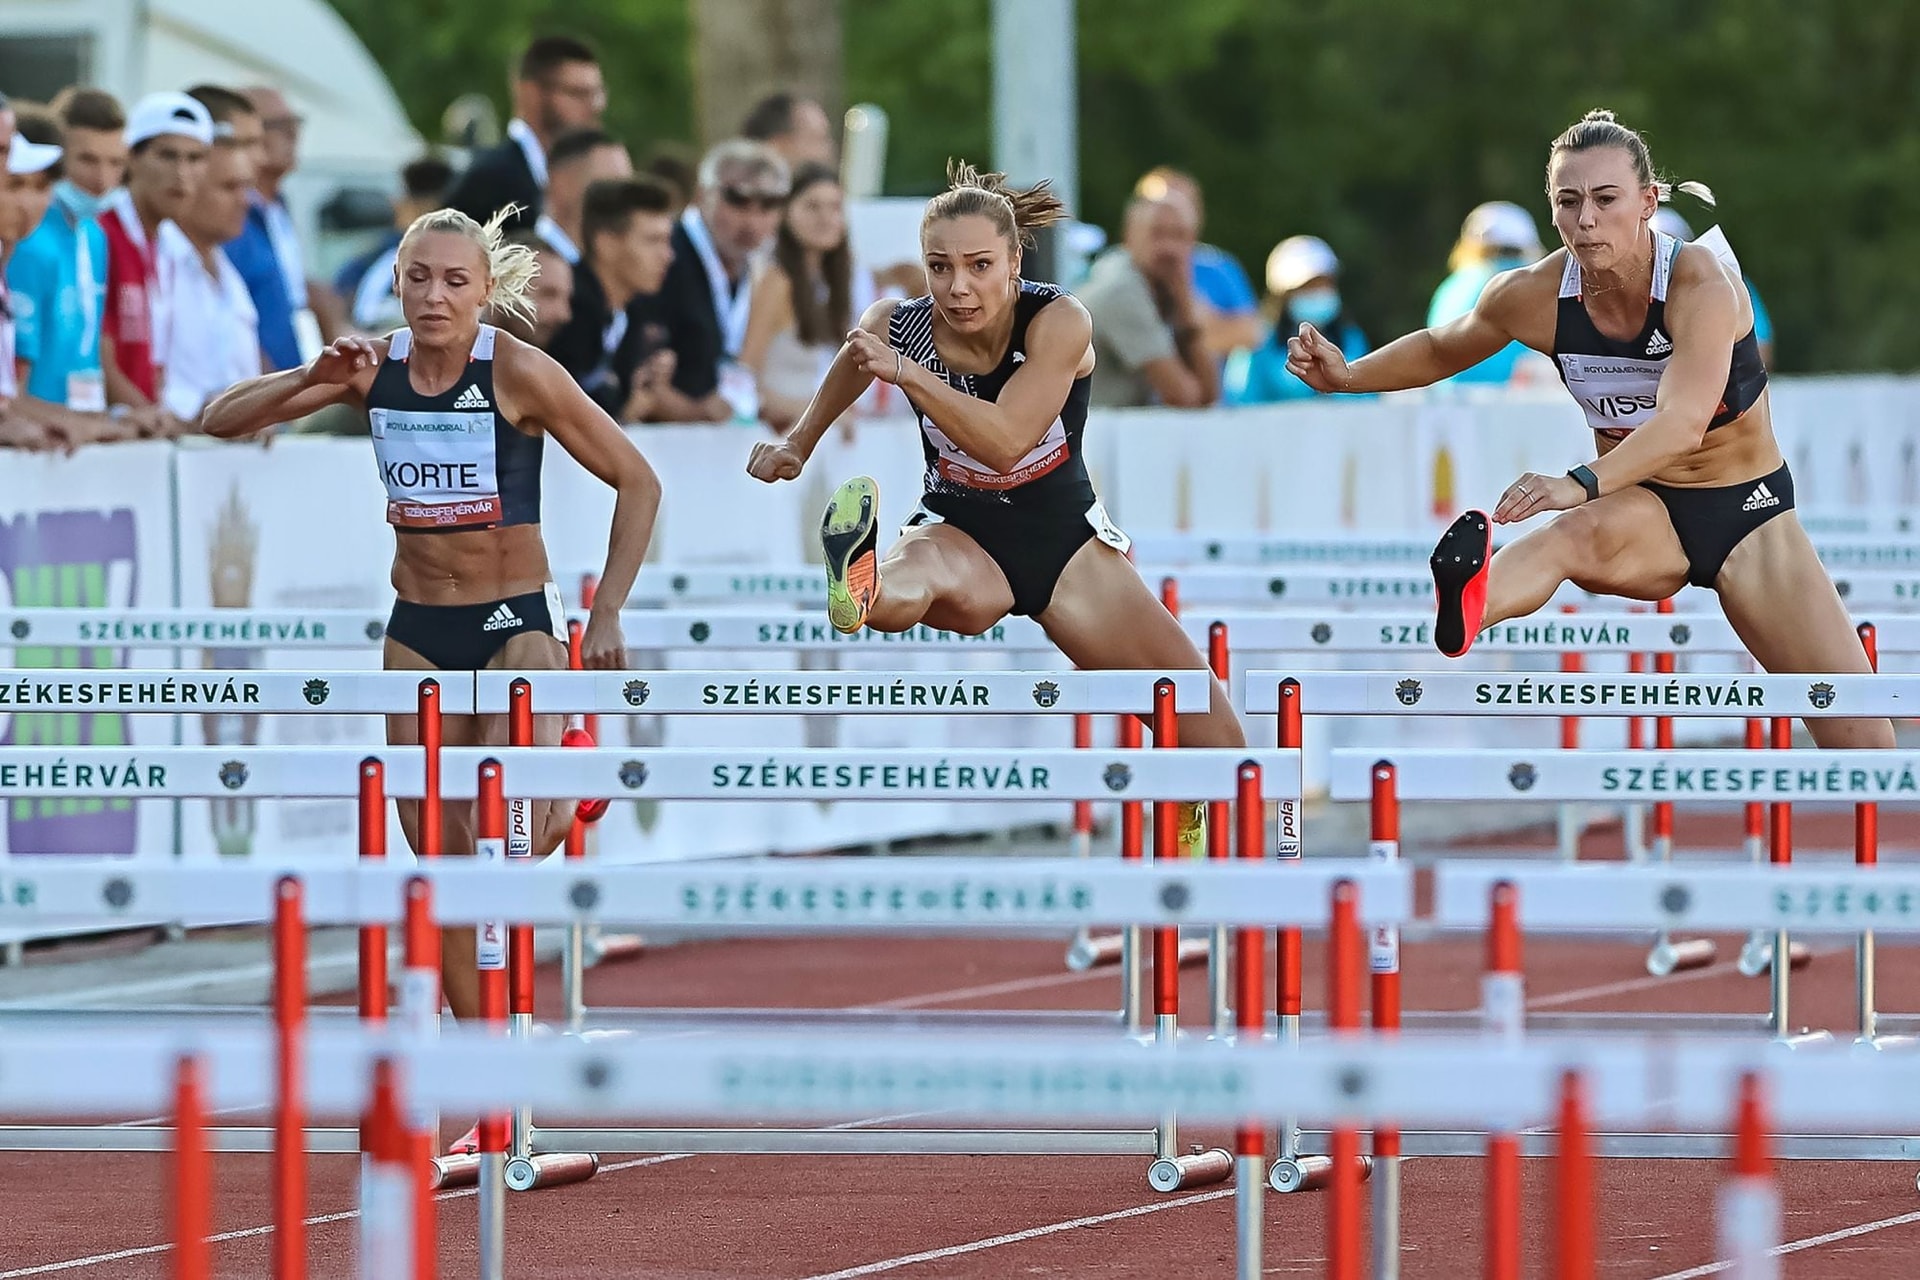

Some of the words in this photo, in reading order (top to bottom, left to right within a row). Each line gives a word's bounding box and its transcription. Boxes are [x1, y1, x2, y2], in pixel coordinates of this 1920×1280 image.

[1645, 343, 1673, 355] adida
[454, 399, 490, 409] adidas
[385, 461, 479, 488] KORTE
[404, 501, 493, 518] SZÉKESFEHÉRVÁR
[1742, 496, 1780, 511] adidas
[436, 515, 457, 524] 2020
[79, 616, 327, 640] SZÉKESFEHÉRVÁR
[483, 617, 523, 631] adidas
[1380, 622, 1630, 644] SZÉFEHÉRVÁR
[702, 679, 990, 706] SZÉKESFEHÉRVÁR
[1475, 678, 1765, 706] SZÉKESFEHÉRVÁR
[712, 759, 1051, 788] SZÉKESFEHÉRVÁR
[511, 798, 527, 836] pola
[1280, 800, 1297, 838] pola
